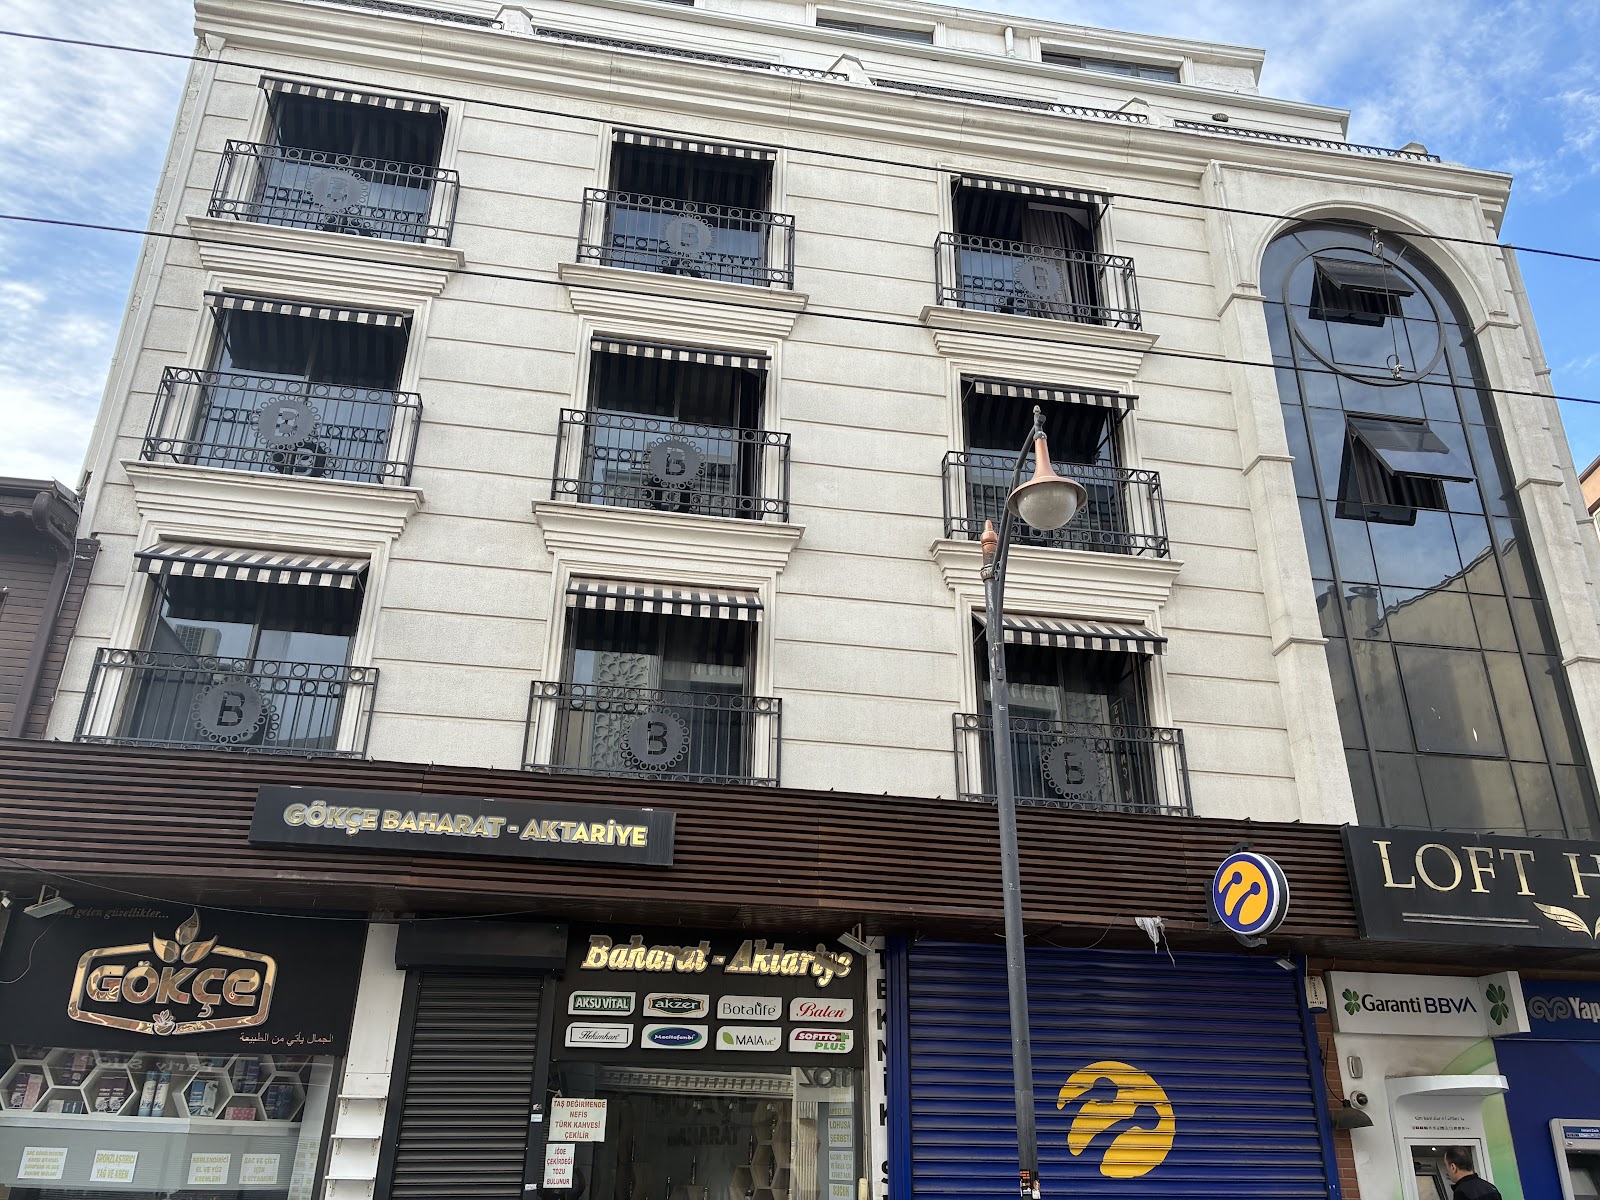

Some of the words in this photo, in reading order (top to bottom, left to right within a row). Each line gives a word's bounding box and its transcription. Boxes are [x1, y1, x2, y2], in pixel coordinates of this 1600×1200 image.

[282, 800, 380, 836] GÖKÇE
[381, 809, 507, 838] BAHARAT
[519, 818, 649, 847] AKTARİYE
[1372, 840, 1536, 896] LOFT
[580, 934, 711, 973] Baharat
[724, 939, 853, 988] Aktariye
[575, 997, 601, 1009] AKSU
[602, 996, 629, 1009] VİTAL
[655, 999, 699, 1009] akzer
[722, 1002, 776, 1016] Botalife
[1361, 994, 1422, 1013] Garanti
[1423, 997, 1477, 1013] BBVA
[796, 1002, 845, 1018] Balen
[239, 1032, 269, 1045] الطبيعة
[271, 1035, 284, 1045] من
[286, 1031, 305, 1046] يأتي
[306, 1033, 334, 1045] الجمال
[798, 1032, 838, 1041] SOFTTO
[814, 1042, 846, 1051] PLUS
[553, 1100, 565, 1109] TAŞ
[566, 1100, 606, 1109] DEĞİRMENDE
[555, 1120, 572, 1129] TÜRK
[574, 1120, 601, 1129] KAHVESİ
[564, 1130, 589, 1140] ÇEKİLİR
